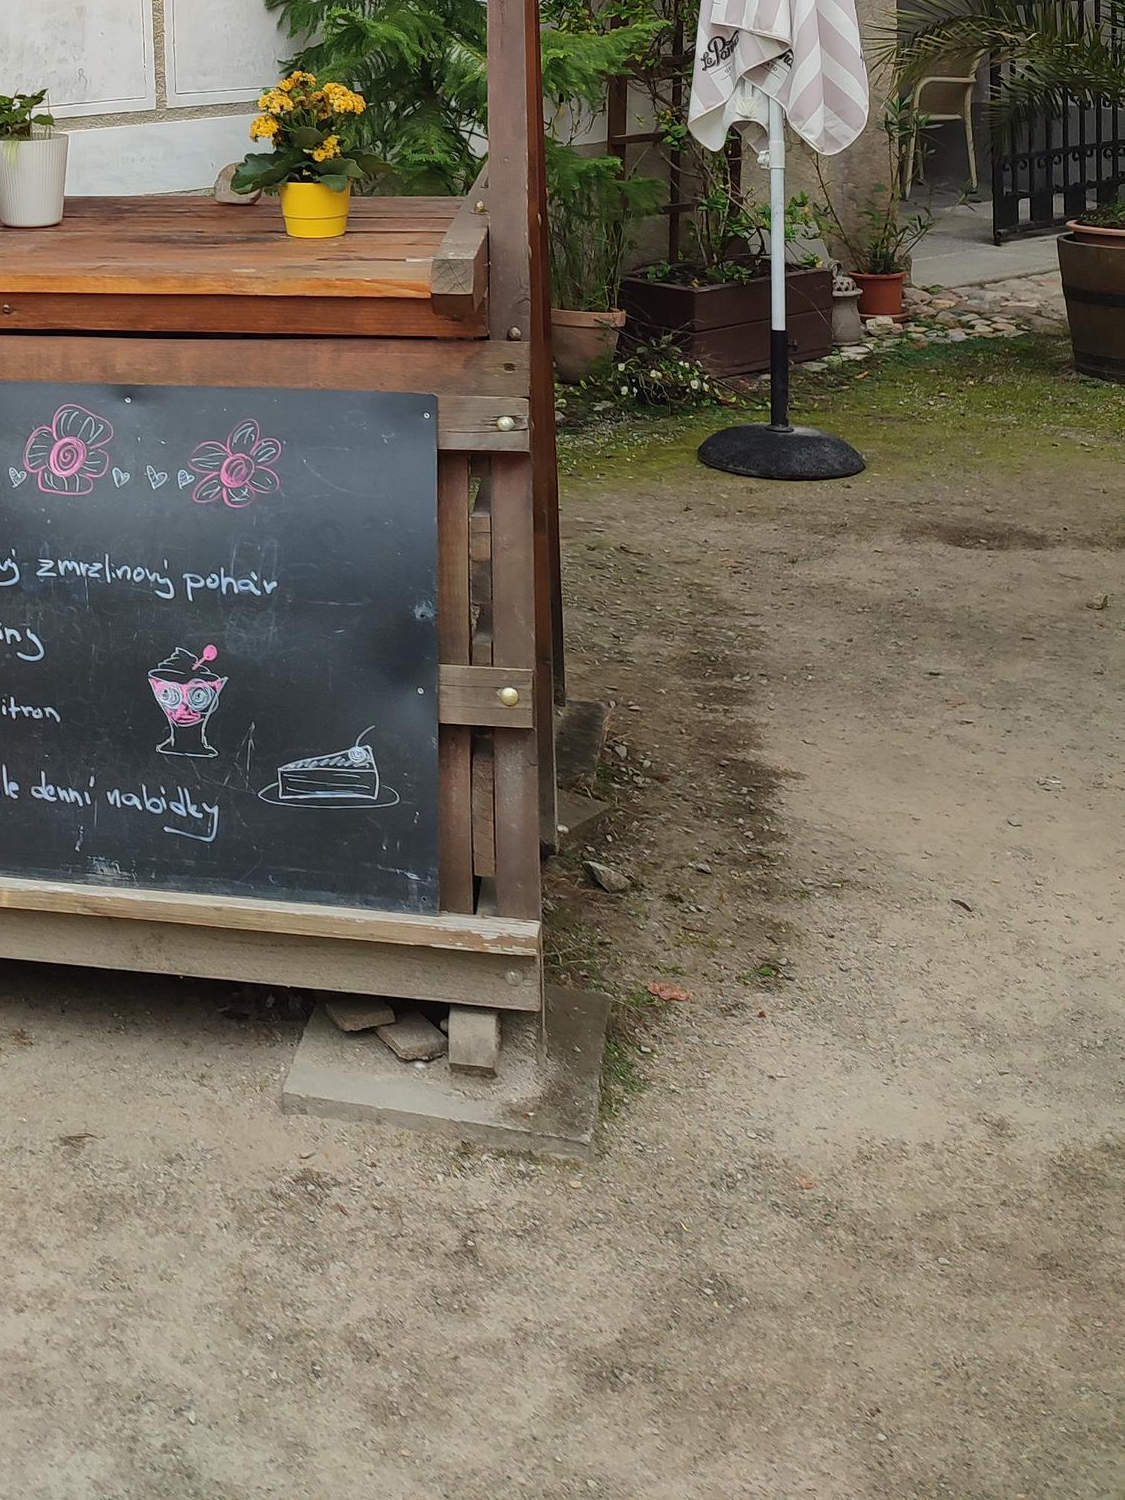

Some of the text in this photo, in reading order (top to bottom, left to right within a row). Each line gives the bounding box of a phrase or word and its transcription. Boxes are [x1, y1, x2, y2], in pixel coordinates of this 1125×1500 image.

[182, 566, 278, 602] pohár
[30, 770, 96, 807] denní
[106, 783, 219, 843] nabídky
